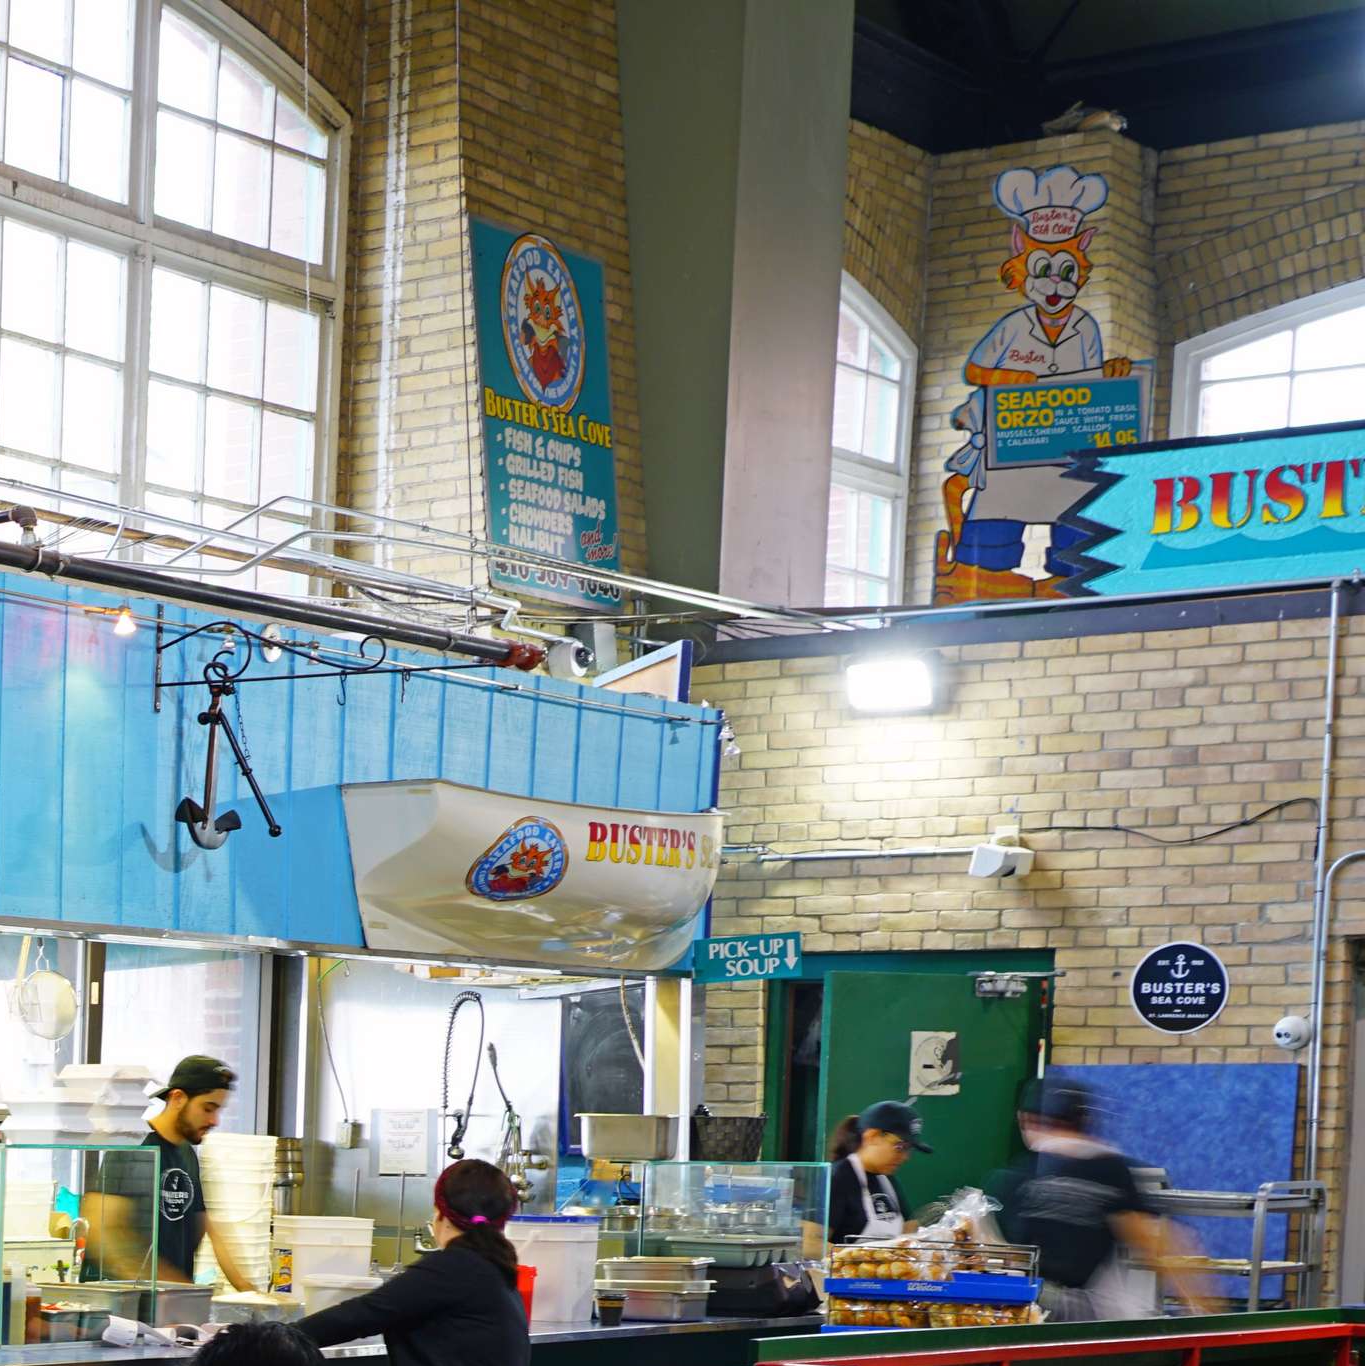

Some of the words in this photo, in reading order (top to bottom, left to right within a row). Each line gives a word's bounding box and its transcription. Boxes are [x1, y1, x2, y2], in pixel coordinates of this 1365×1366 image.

[997, 388, 1091, 410] SEAFOOD
[997, 408, 1054, 429] ORZO
[505, 428, 533, 454] FISH
[578, 415, 613, 448] COVE
[1151, 457, 1365, 535] BUST
[586, 821, 696, 869] BUSTER'S
[709, 938, 784, 959] PICK-UP
[725, 957, 780, 977] SOUP
[1141, 982, 1221, 994] BUSTER'S
[1150, 996, 1172, 1005] SEA
[1175, 996, 1206, 1005] COVE
